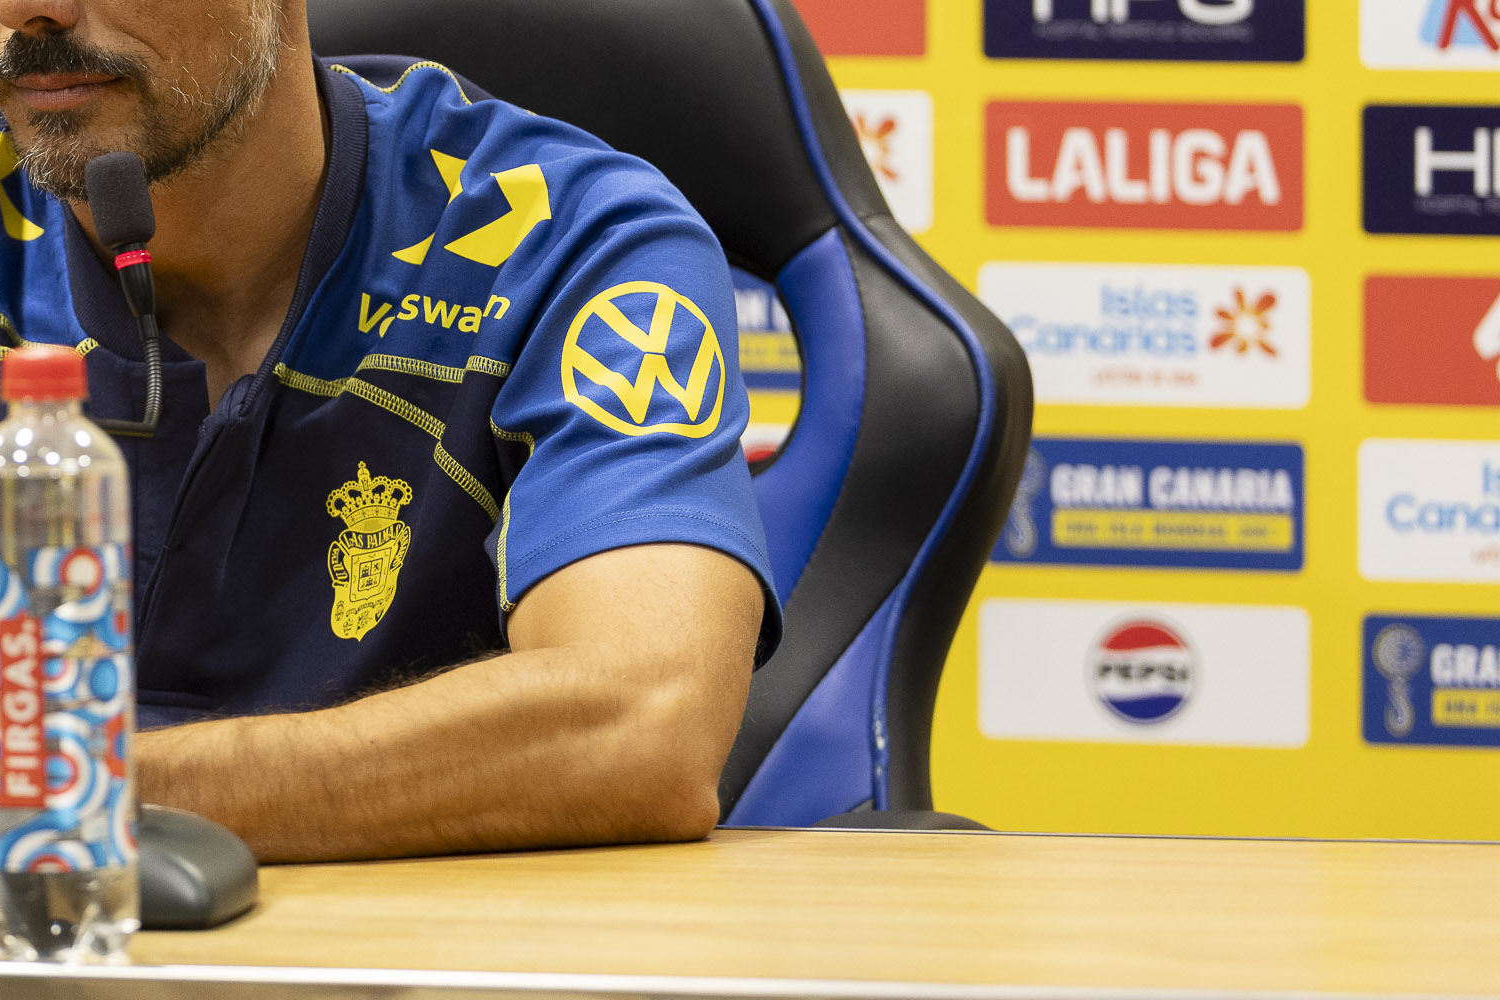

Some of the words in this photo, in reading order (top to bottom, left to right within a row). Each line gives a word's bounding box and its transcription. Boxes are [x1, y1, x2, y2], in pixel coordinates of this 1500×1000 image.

[1005, 127, 1282, 205] LALIGA
[1385, 492, 1500, 534] Cana
[1431, 643, 1500, 688] GRA
